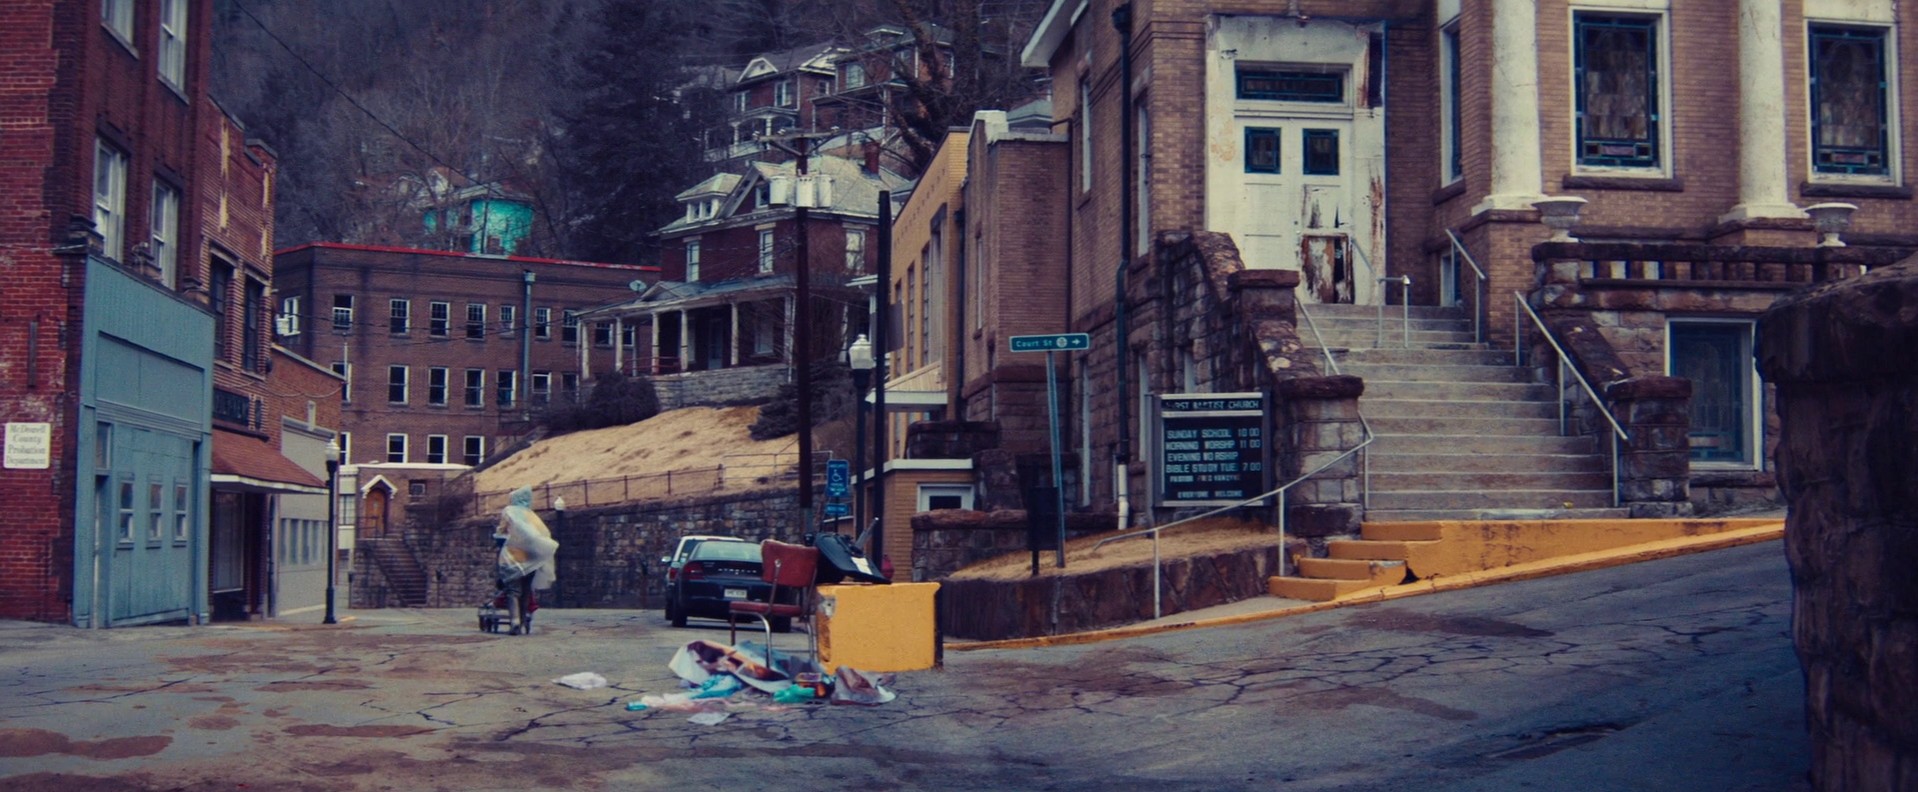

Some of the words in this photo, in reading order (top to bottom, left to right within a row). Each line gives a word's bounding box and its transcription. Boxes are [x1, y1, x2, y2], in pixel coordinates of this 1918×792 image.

[1228, 400, 1259, 409] CHURCH
[1167, 430, 1197, 439] SUNDAY
[1201, 429, 1232, 438] SCHOOL
[12, 434, 42, 445] County
[1166, 441, 1199, 450] MORNING
[1167, 452, 1201, 462] EVENING
[1166, 464, 1190, 473] BIBLE
[1192, 464, 1218, 473] STUDY
